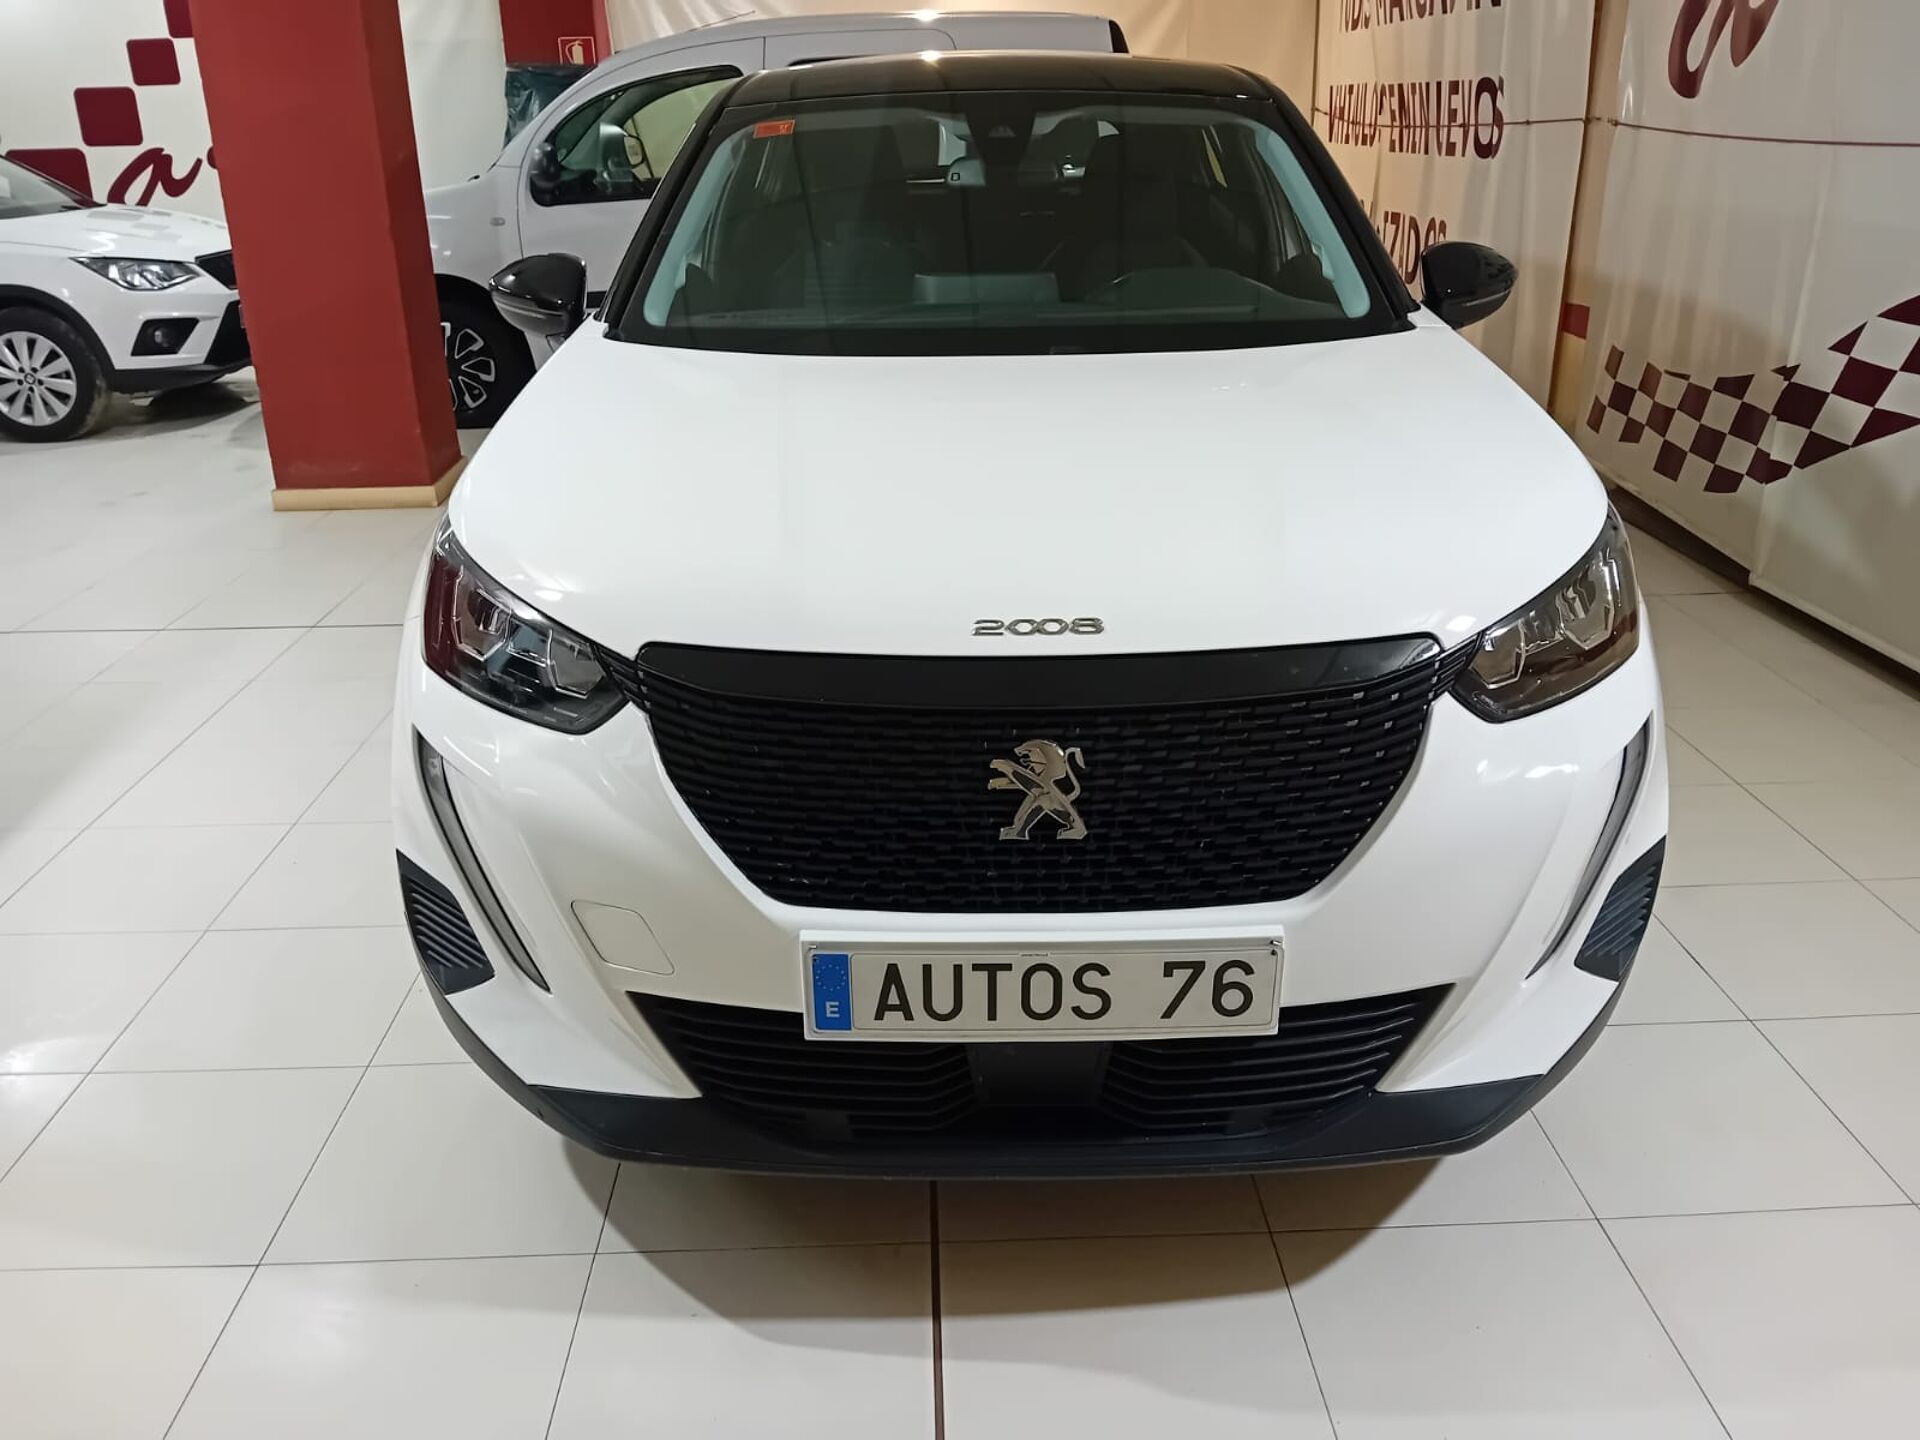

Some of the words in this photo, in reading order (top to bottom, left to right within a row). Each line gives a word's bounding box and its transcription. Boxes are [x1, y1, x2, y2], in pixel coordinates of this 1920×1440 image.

[972, 617, 1105, 637] 2008
[825, 1001, 841, 1019] E
[874, 962, 1113, 1022] AUTOS
[1160, 959, 1256, 1020] 76
